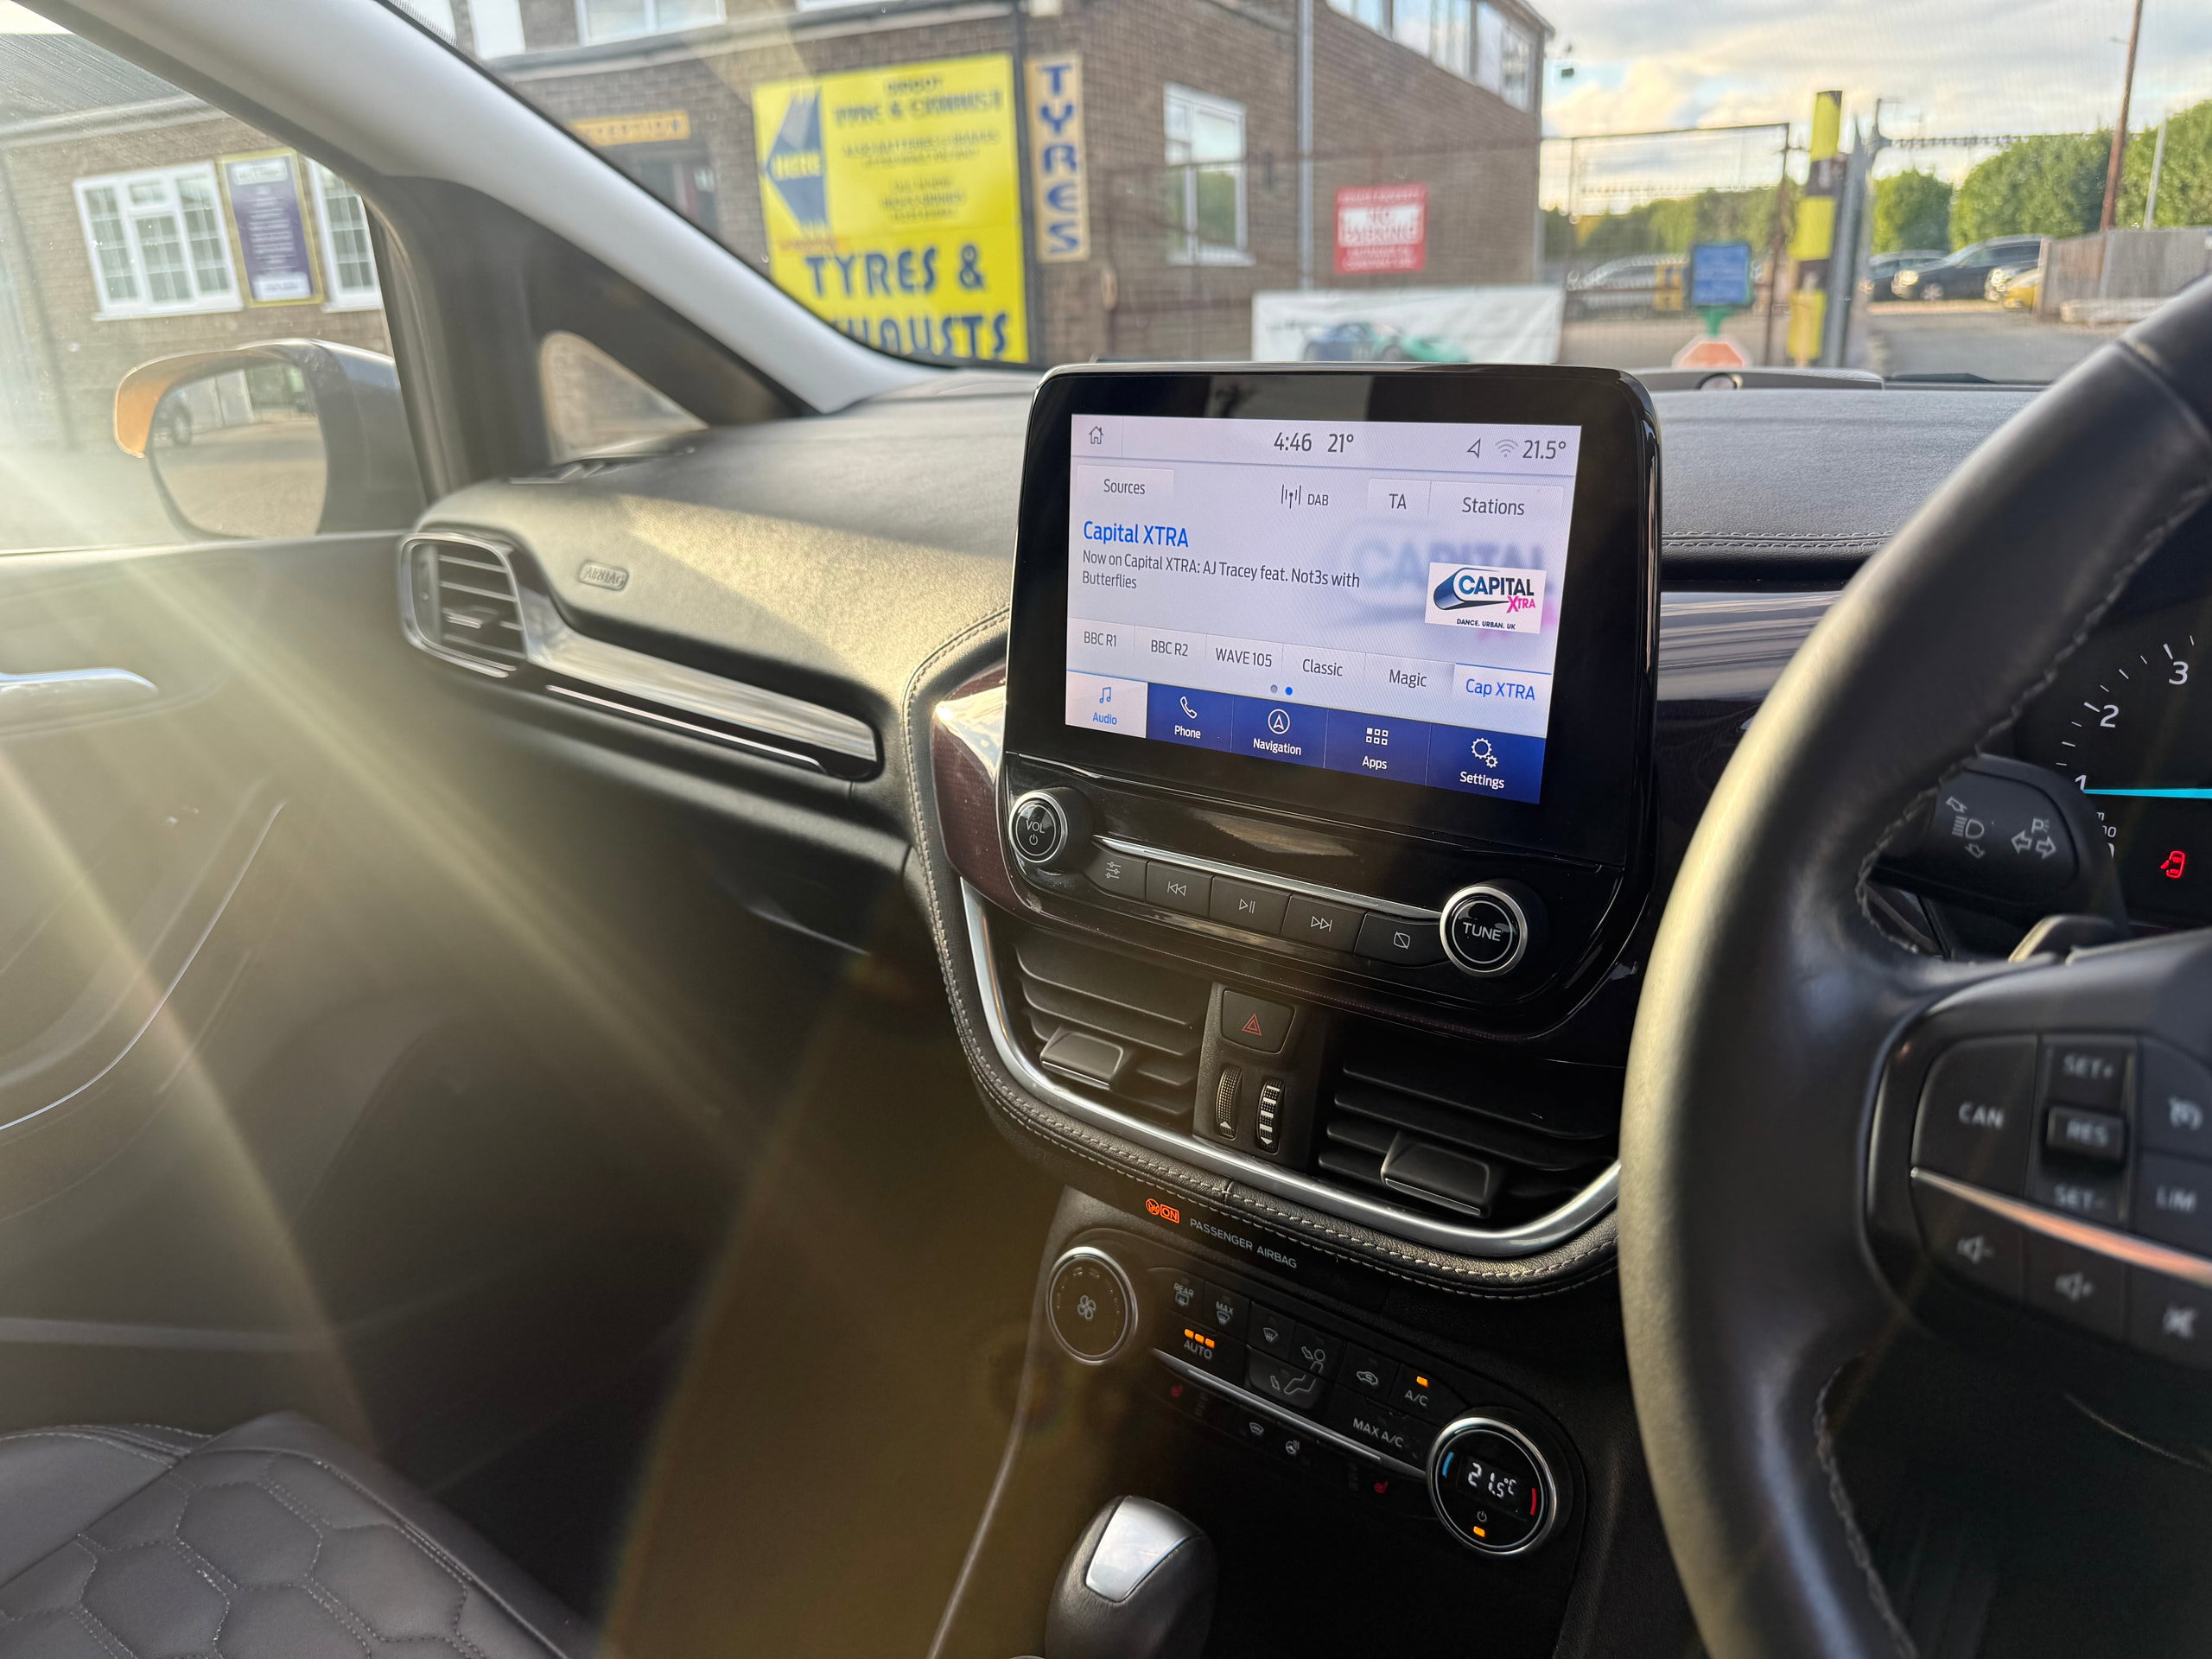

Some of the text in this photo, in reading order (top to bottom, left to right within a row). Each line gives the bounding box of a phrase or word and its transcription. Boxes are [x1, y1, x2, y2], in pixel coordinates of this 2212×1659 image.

[1040, 66, 1077, 253] TYRES
[804, 244, 986, 298] TYRES &
[1274, 433, 1354, 453] 4:46 21°
[1522, 441, 1567, 461] 21.5°
[1103, 479, 1146, 496] Sources
[1307, 493, 1329, 506] DAB
[1389, 493, 1407, 510] TA
[1462, 497, 1525, 516] Stations
[1084, 521, 1189, 548] Capital XTRA
[1083, 550, 1360, 588] Now on Capital XTRA: AJ Tracey feat. Not3s with
[1083, 570, 1137, 588] Butterflies
[1459, 575, 1535, 596] CAPITAL
[1506, 595, 1535, 613] XTRA
[1482, 620, 1504, 629] URBAN.
[1084, 631, 1116, 647] BBC R1
[1151, 639, 1188, 657] BBC R2
[1215, 647, 1272, 667] WAVE 105
[1302, 658, 1343, 677] Classic
[2168, 661, 2189, 684] 3
[1389, 670, 1427, 689] Magic
[1465, 678, 1535, 701] Cap XTRA
[1092, 712, 1117, 725] Audio
[2100, 704, 2120, 728] 2
[1174, 725, 1200, 739] Phone
[1253, 738, 1302, 755] Navigation
[1362, 755, 1387, 771] Apps
[1459, 771, 1504, 790] Settings
[1026, 819, 1045, 834] VOL
[1463, 922, 1502, 941] TUNE
[1958, 1101, 2005, 1130] CAN
[2067, 1120, 2108, 1147] RES
[2156, 1186, 2197, 1211] LIM
[1162, 1207, 1178, 1222] ON
[1190, 1218, 1297, 1269] PASSENGER AIRBAG
[1173, 1282, 1194, 1297] REAR
[1216, 1301, 1234, 1315] MAX
[1184, 1340, 1213, 1359] AUTO
[1404, 1389, 1428, 1408] A/C
[1352, 1418, 1404, 1449] MAX A/C
